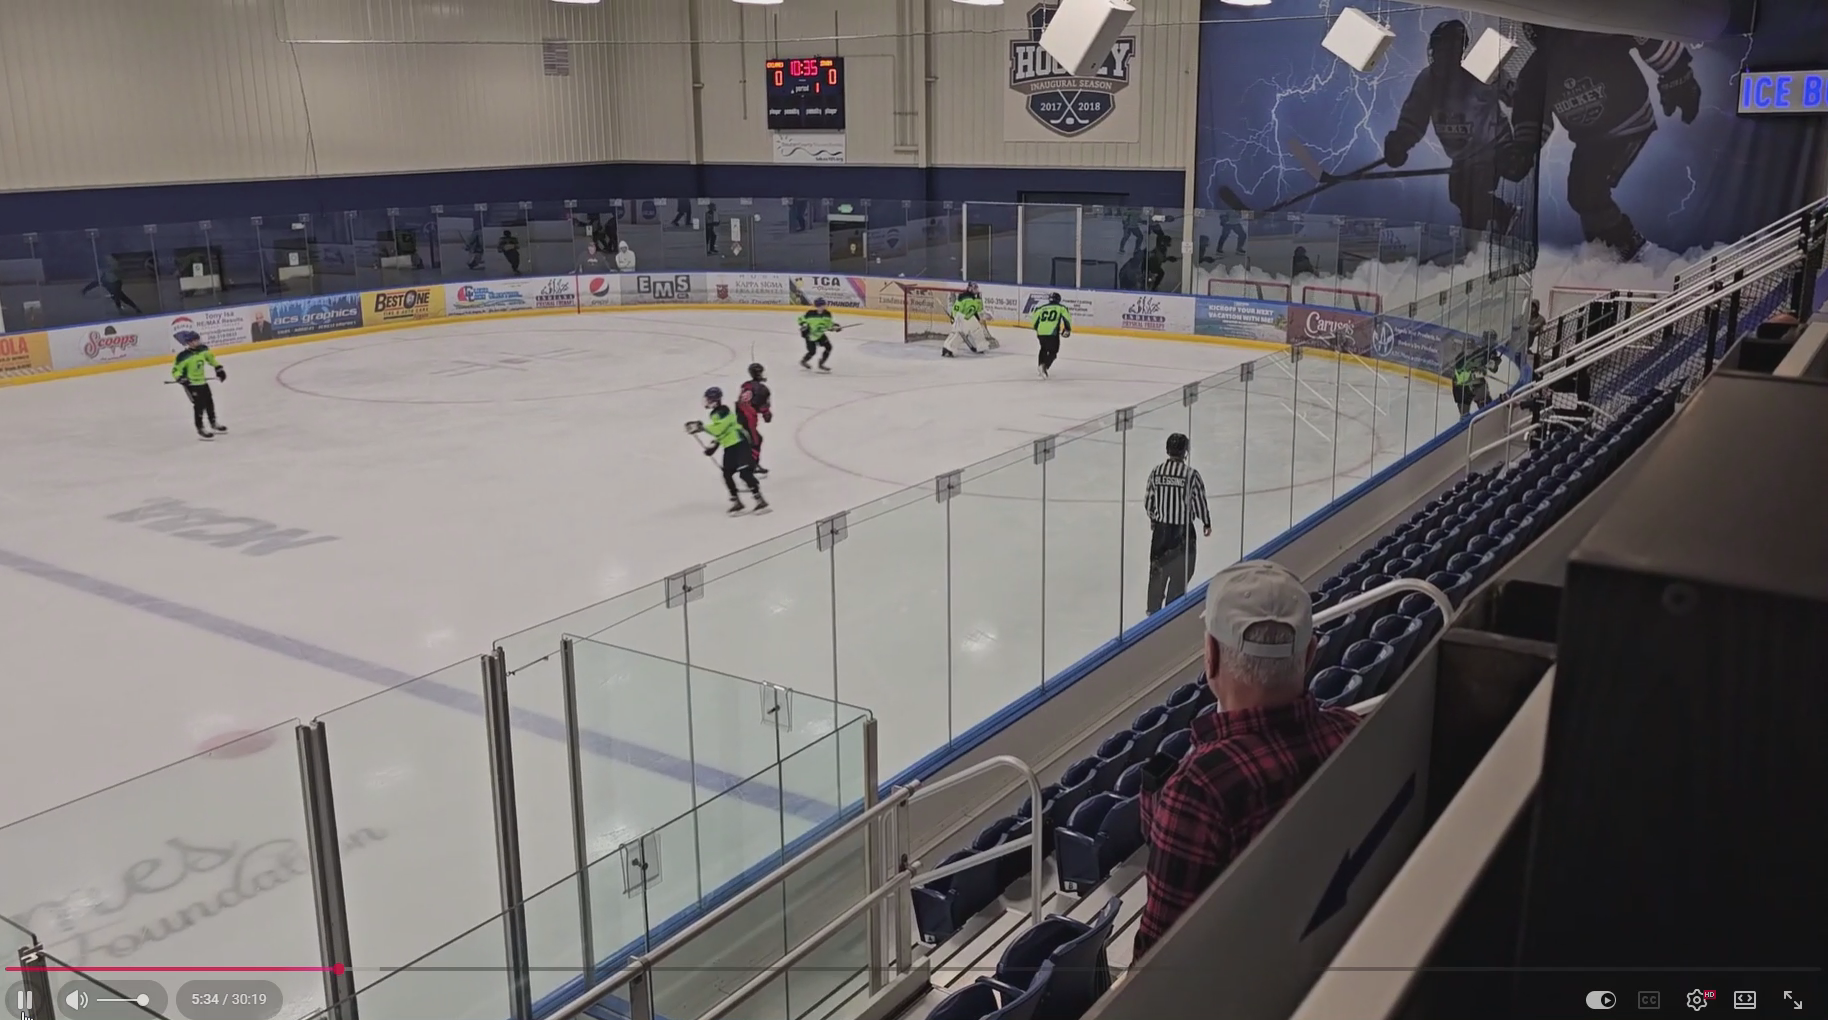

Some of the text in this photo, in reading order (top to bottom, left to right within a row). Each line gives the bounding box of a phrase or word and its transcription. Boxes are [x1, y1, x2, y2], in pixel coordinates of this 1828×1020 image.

[790, 60, 818, 76] 10:35
[775, 70, 783, 86] 0
[828, 68, 837, 85] 0
[815, 82, 820, 93] 1
[1030, 80, 1113, 91] INAUGURAL SEASON
[1743, 74, 1828, 108] ICE B
[1040, 102, 1101, 111] 2017 2018
[1554, 86, 1603, 113] HOCKEY
[637, 275, 691, 299] EMS
[812, 276, 841, 286] TCA
[273, 307, 358, 325] acs graphics
[1208, 312, 1241, 320] VACATION
[84, 331, 138, 359] Scoops
